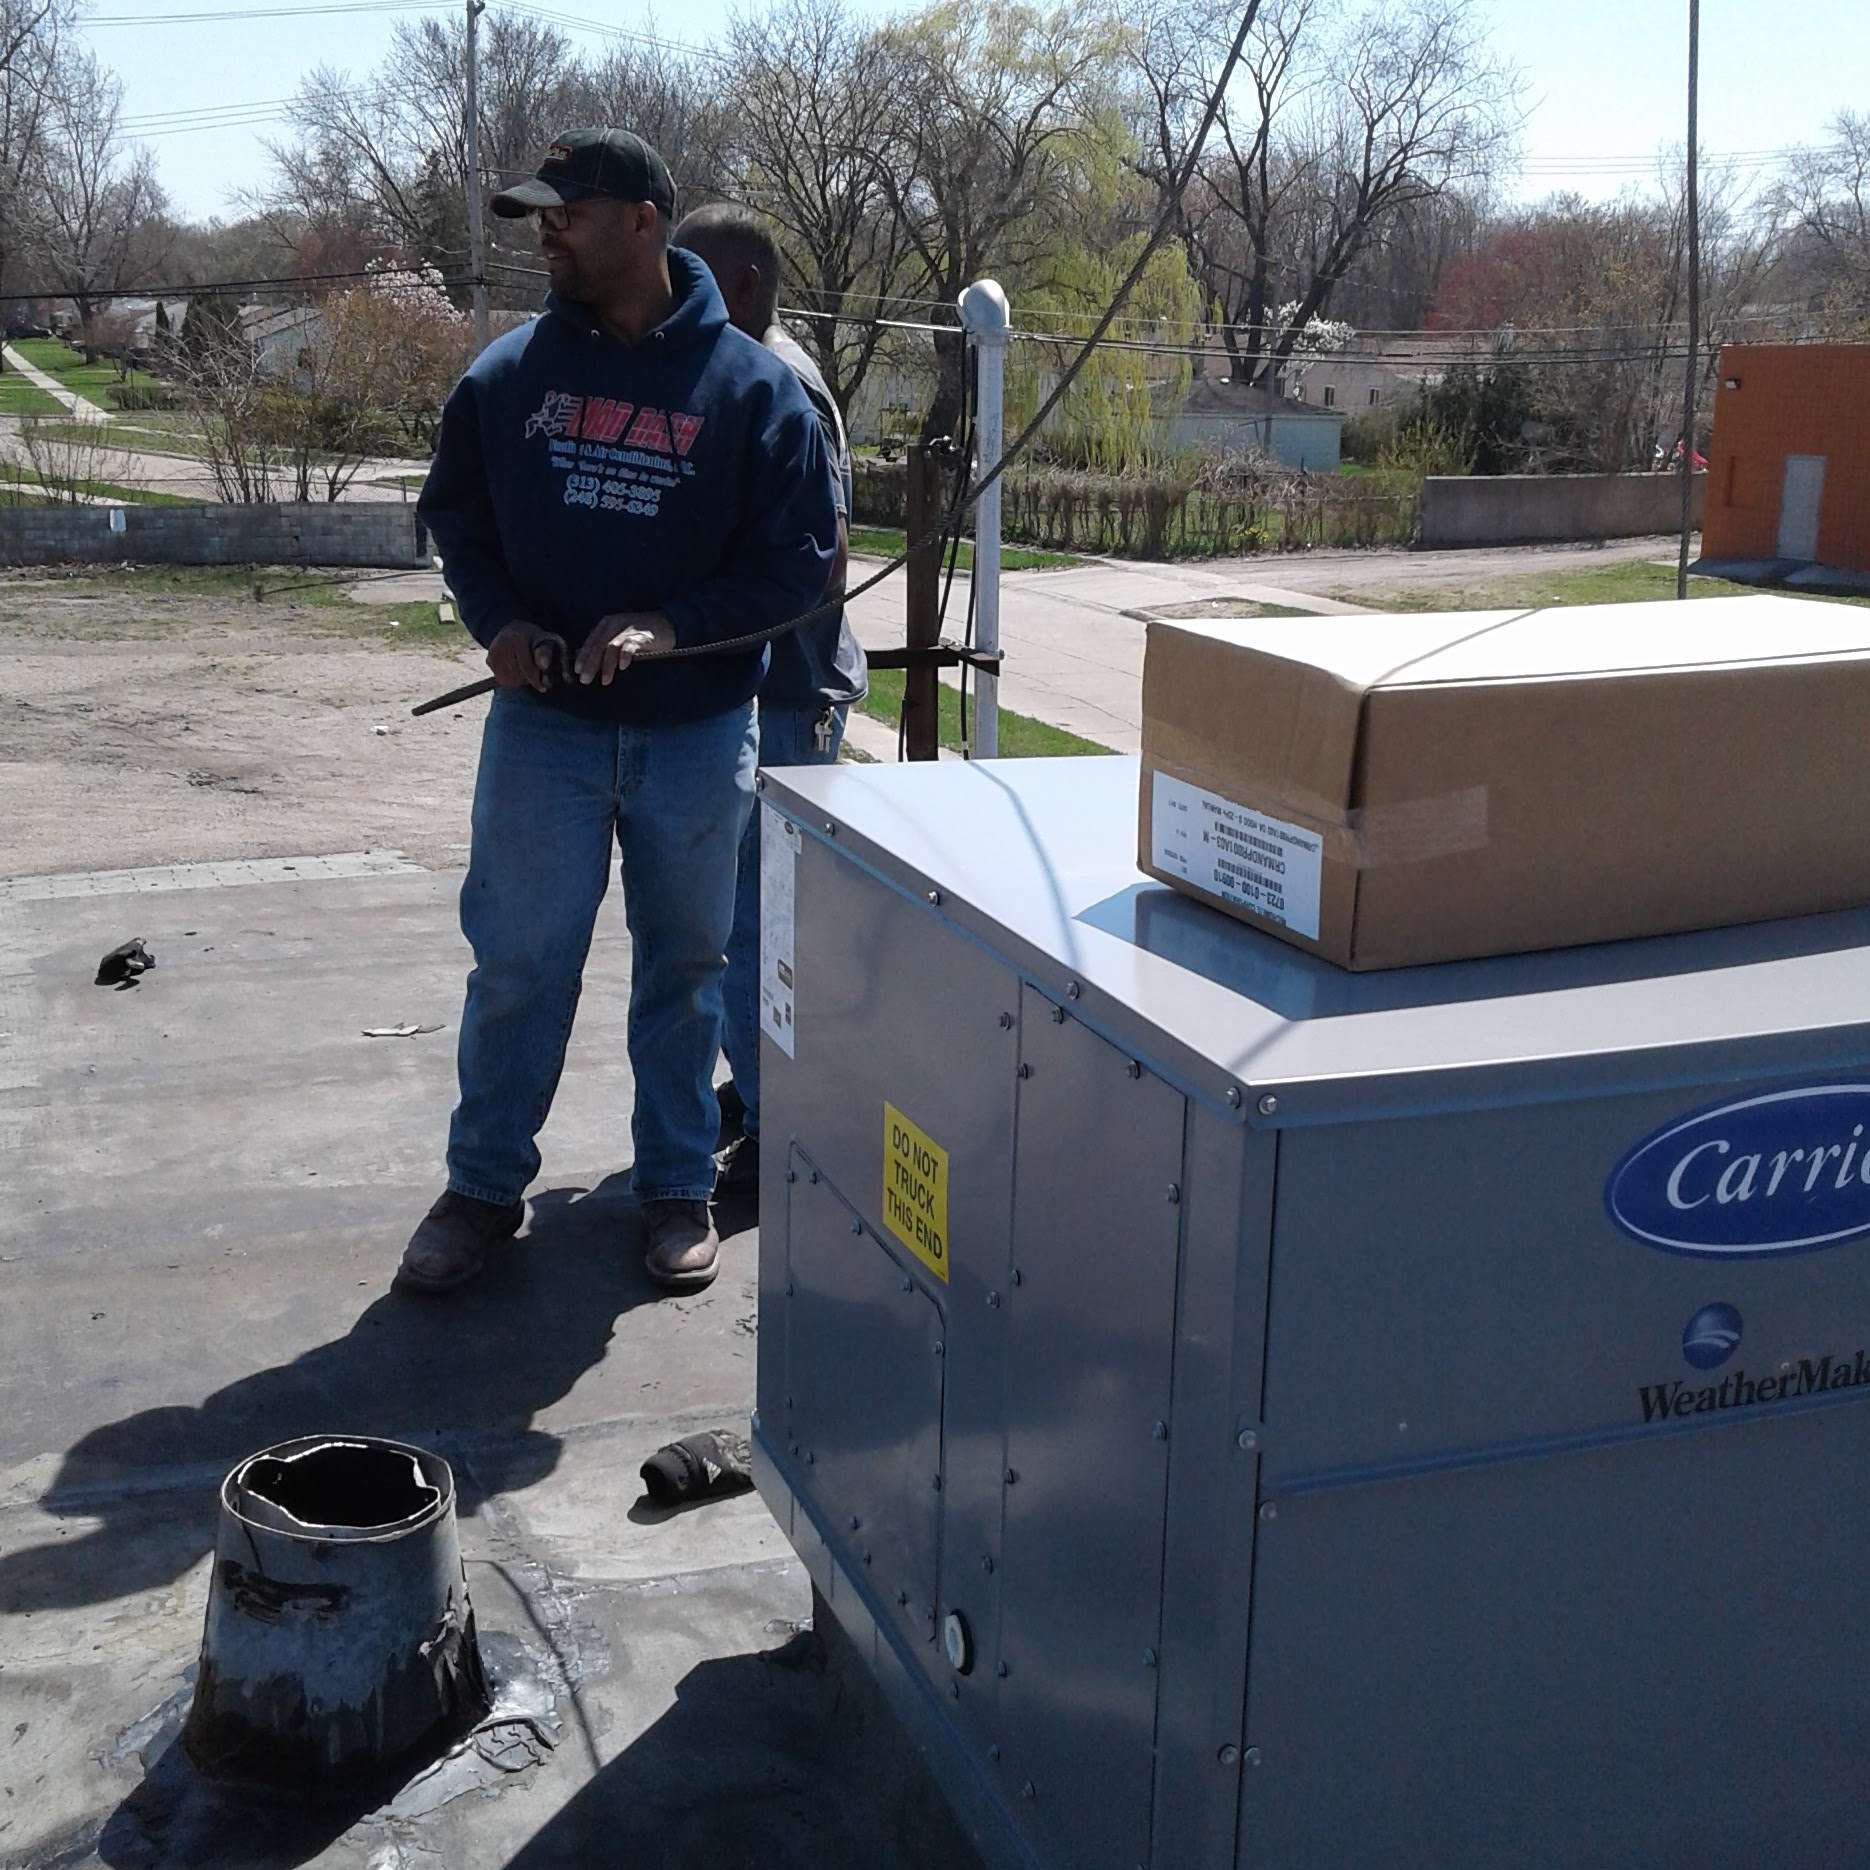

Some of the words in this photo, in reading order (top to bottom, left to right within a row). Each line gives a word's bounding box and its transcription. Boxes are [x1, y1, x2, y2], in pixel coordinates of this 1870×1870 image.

[892, 1124, 910, 1158] DO
[913, 1141, 939, 1185] NOT
[894, 1159, 935, 1220] TRUCK
[887, 1187, 913, 1233] THIS
[915, 1217, 943, 1260] END
